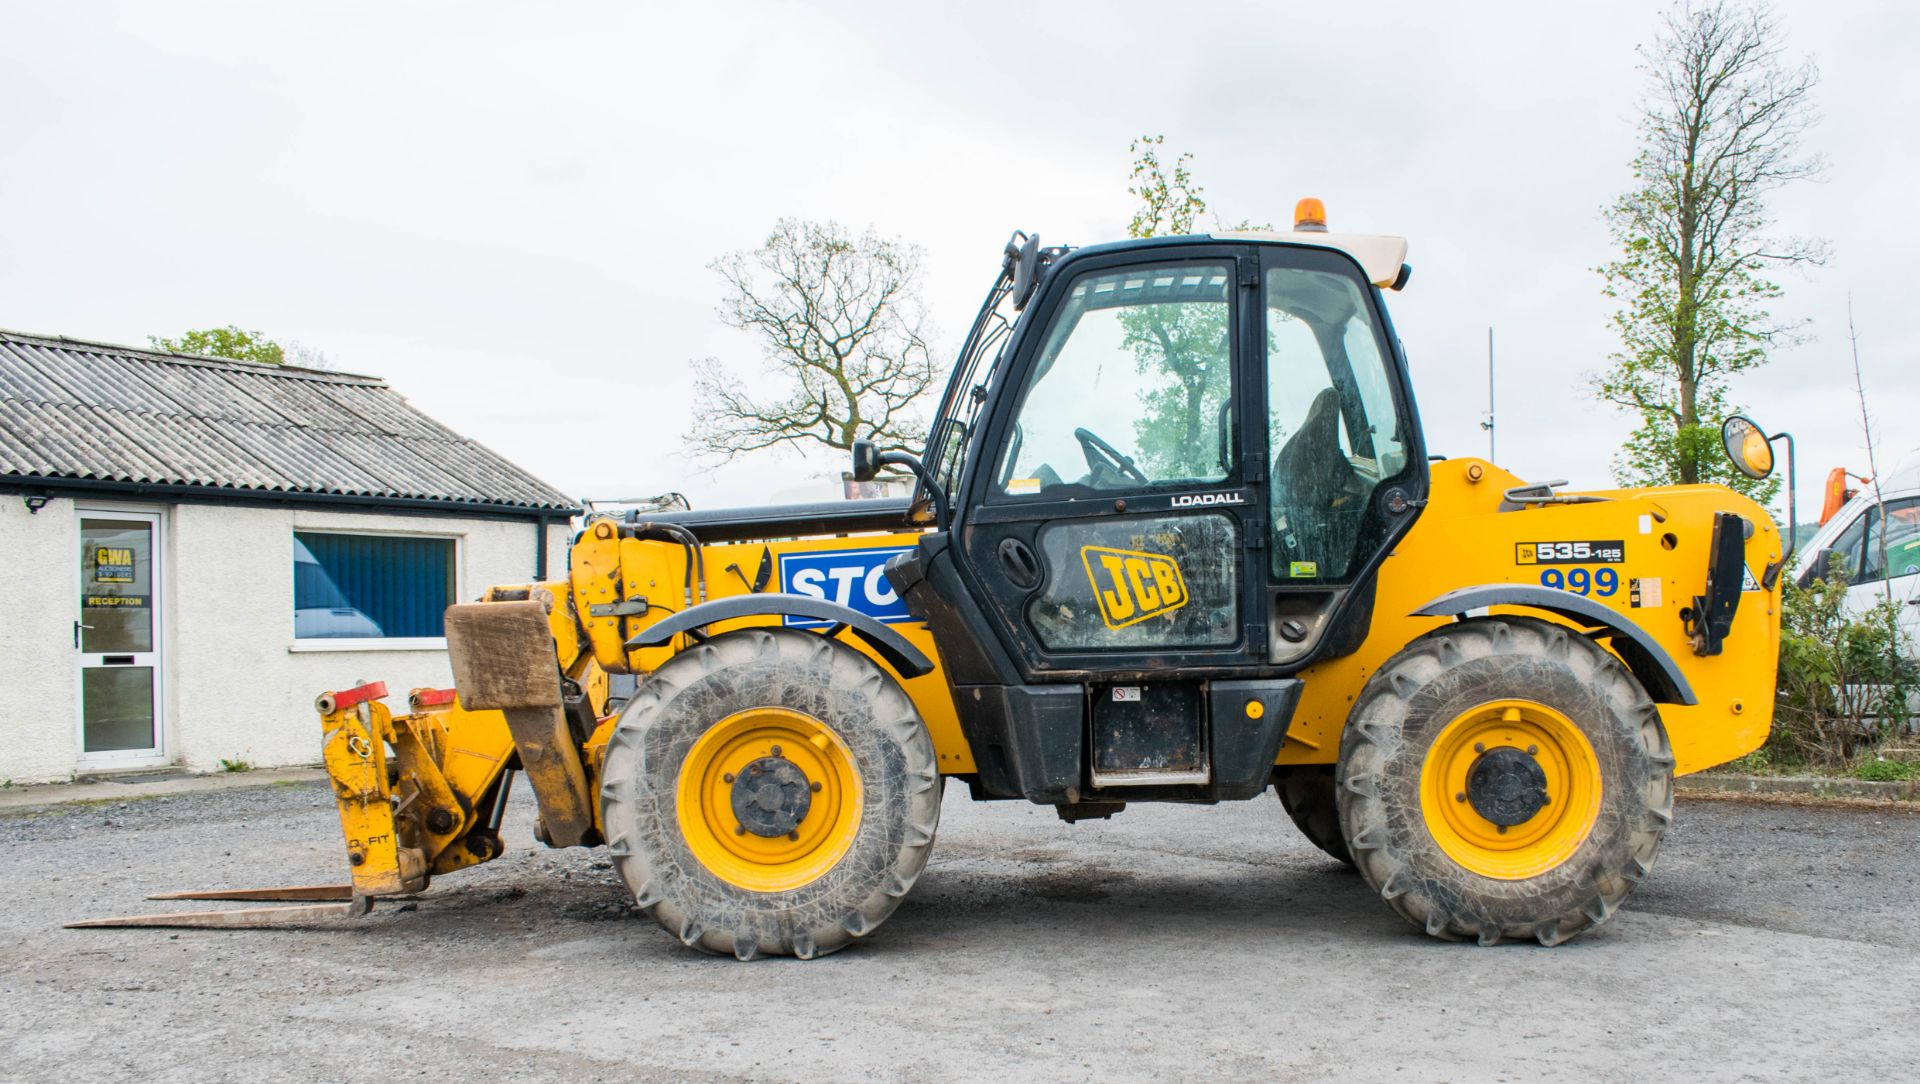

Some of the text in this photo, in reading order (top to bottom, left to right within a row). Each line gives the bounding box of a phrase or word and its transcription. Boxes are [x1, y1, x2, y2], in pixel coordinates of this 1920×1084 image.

[1171, 493, 1244, 507] LOADALL
[97, 549, 132, 566] GWA
[1100, 555, 1181, 621] JCB
[1541, 568, 1619, 597] 999
[88, 597, 142, 606] RECEPTION
[368, 833, 389, 846] FIT
